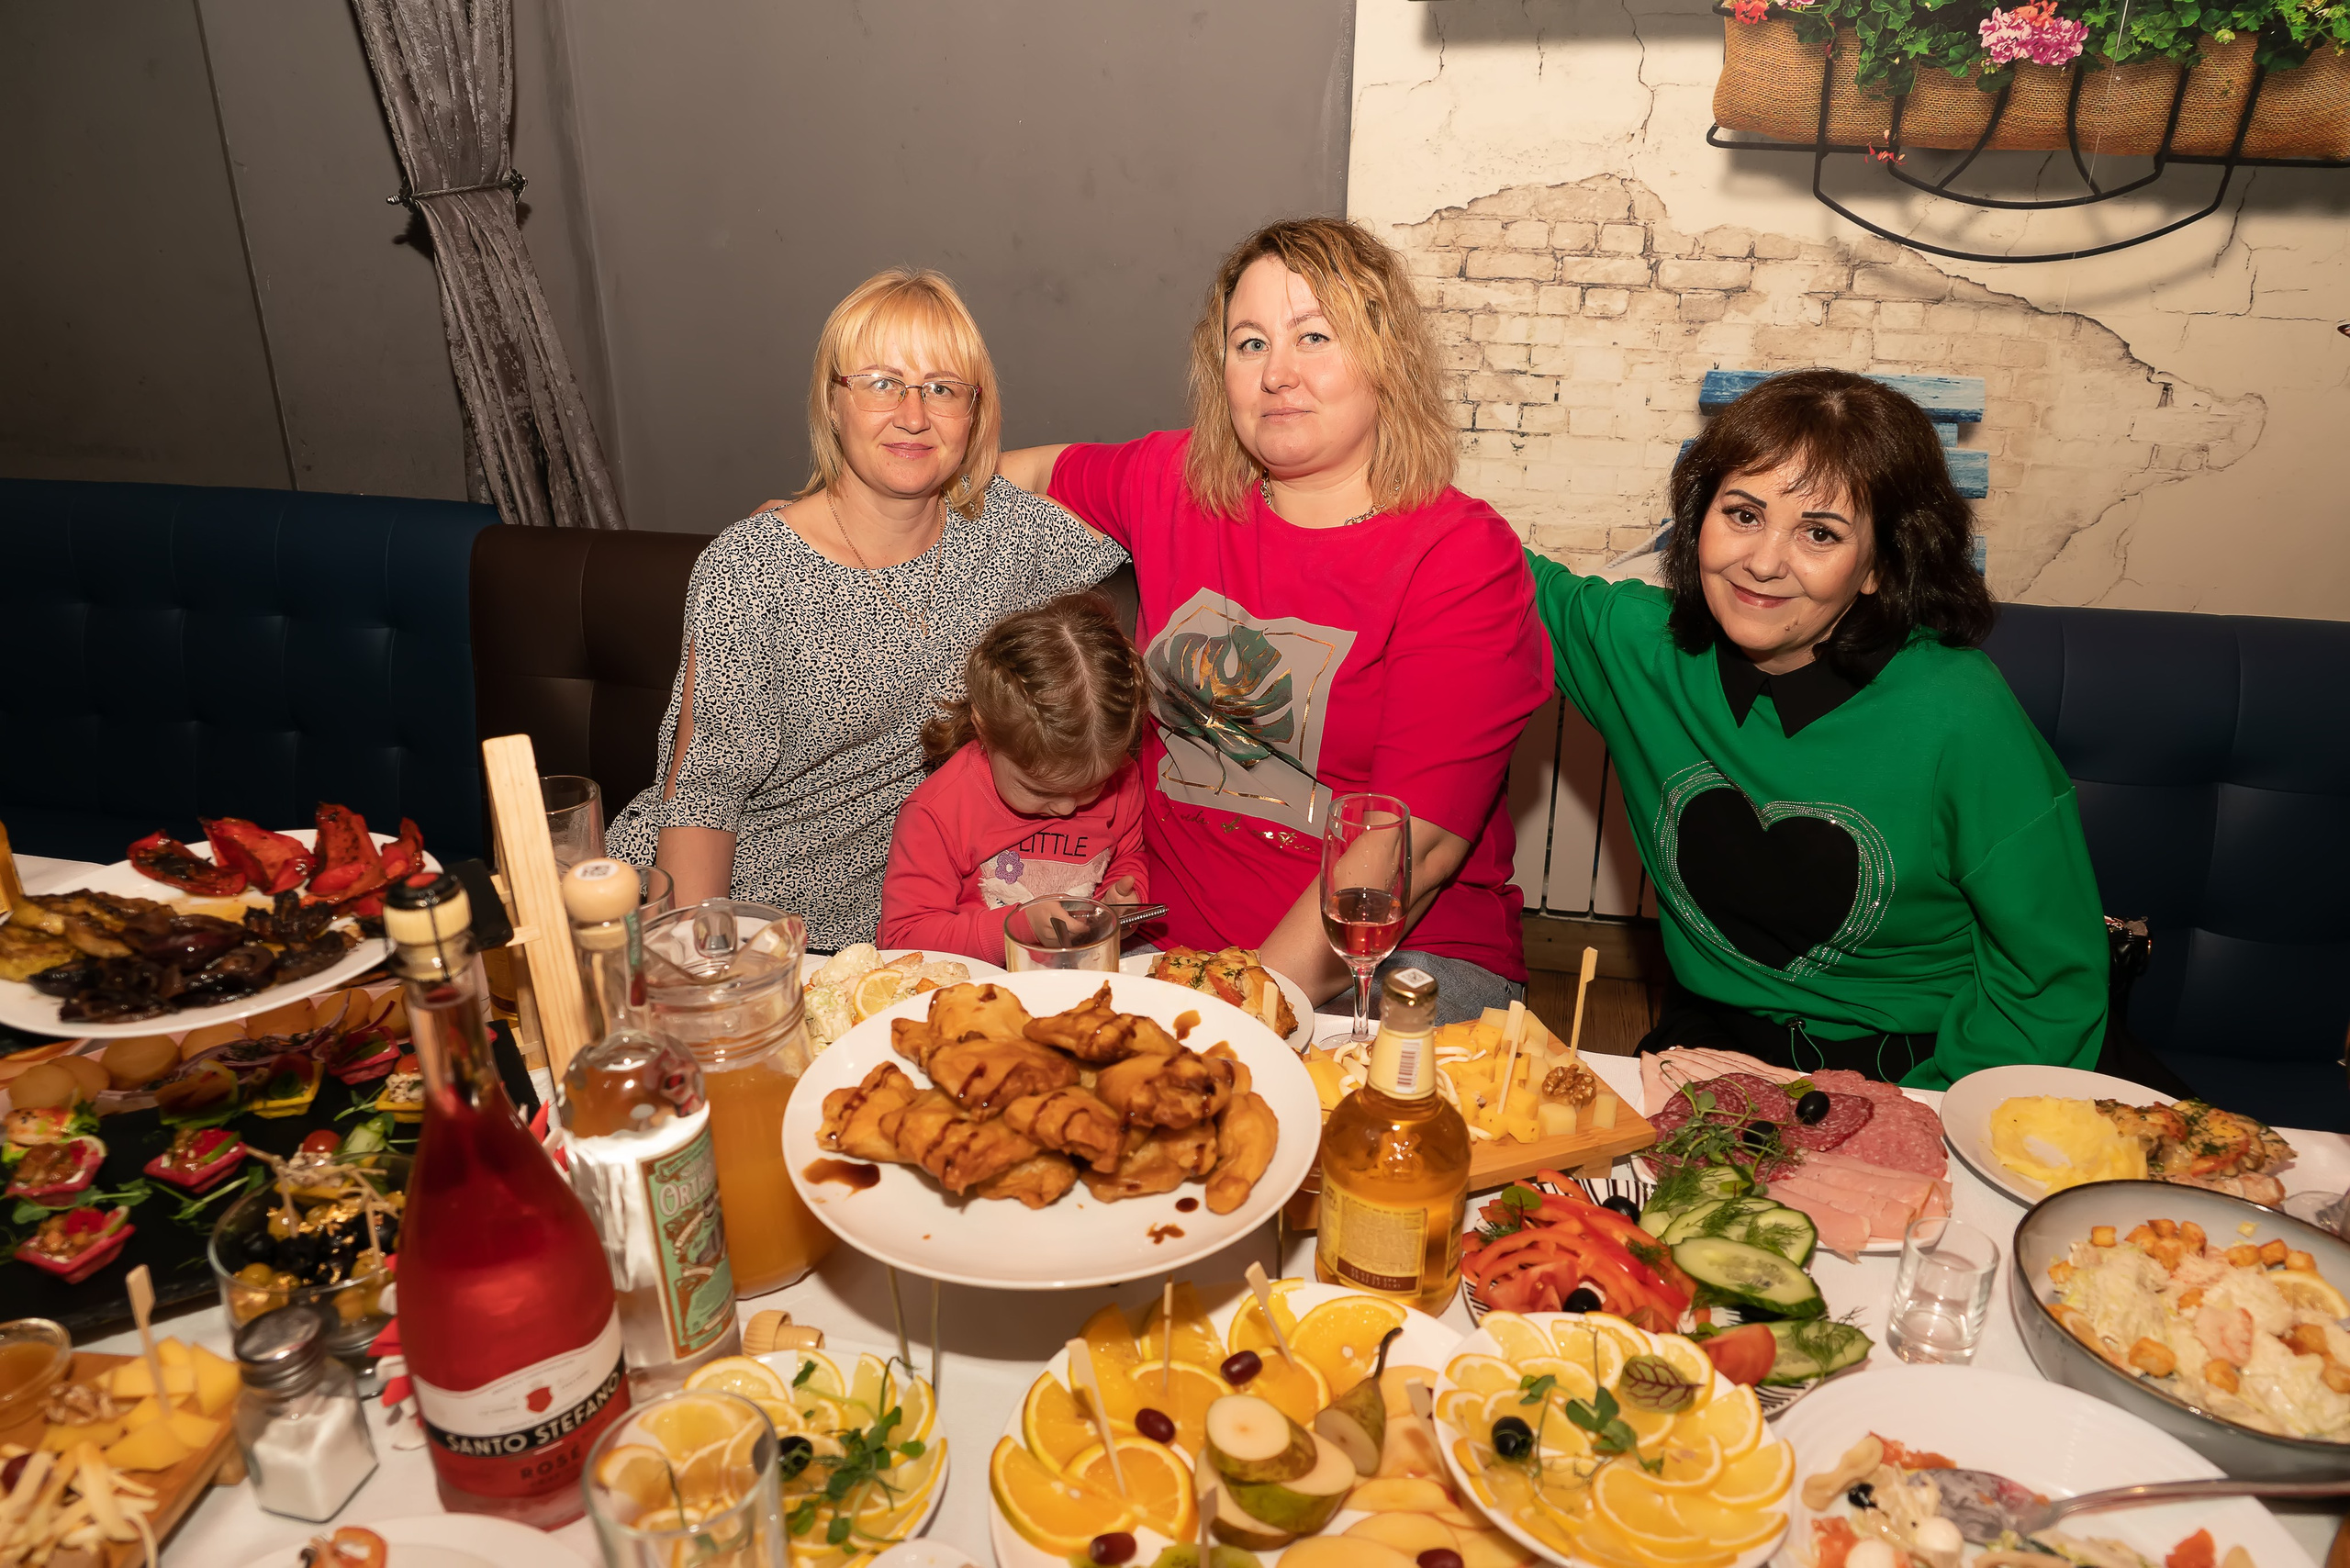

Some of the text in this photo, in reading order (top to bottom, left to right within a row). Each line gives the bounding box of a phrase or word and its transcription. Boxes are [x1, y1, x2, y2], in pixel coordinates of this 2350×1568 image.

[1019, 832, 1089, 857] LITTLE
[445, 1433, 528, 1456] SANTO
[534, 1372, 621, 1445] STEFANO
